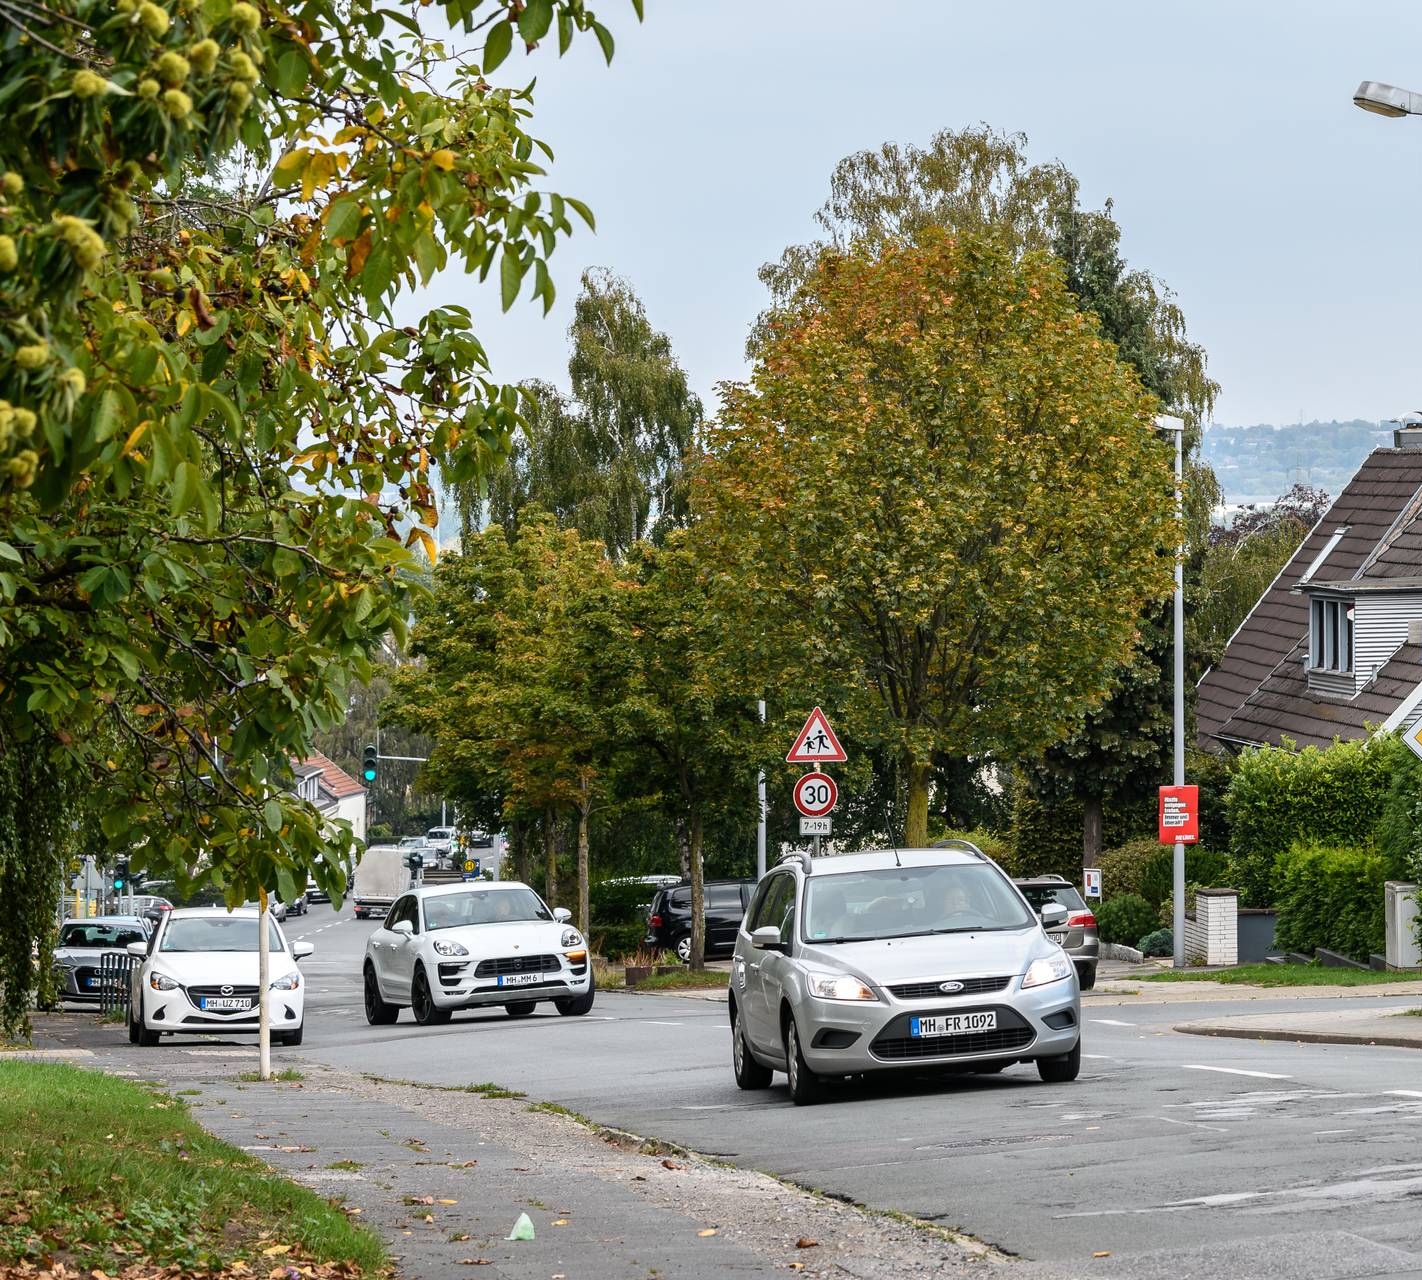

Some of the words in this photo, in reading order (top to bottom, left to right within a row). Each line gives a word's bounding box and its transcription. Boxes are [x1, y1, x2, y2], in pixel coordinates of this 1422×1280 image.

[804, 785, 829, 804] 30
[506, 976, 517, 984] MH
[520, 974, 532, 983] MM
[532, 974, 538, 982] 6
[206, 999, 218, 1007] MH
[222, 999, 233, 1007] UZ
[235, 999, 250, 1007] 710
[920, 1018, 936, 1033] MH
[945, 1016, 961, 1031] FR
[963, 1013, 994, 1029] 1092
